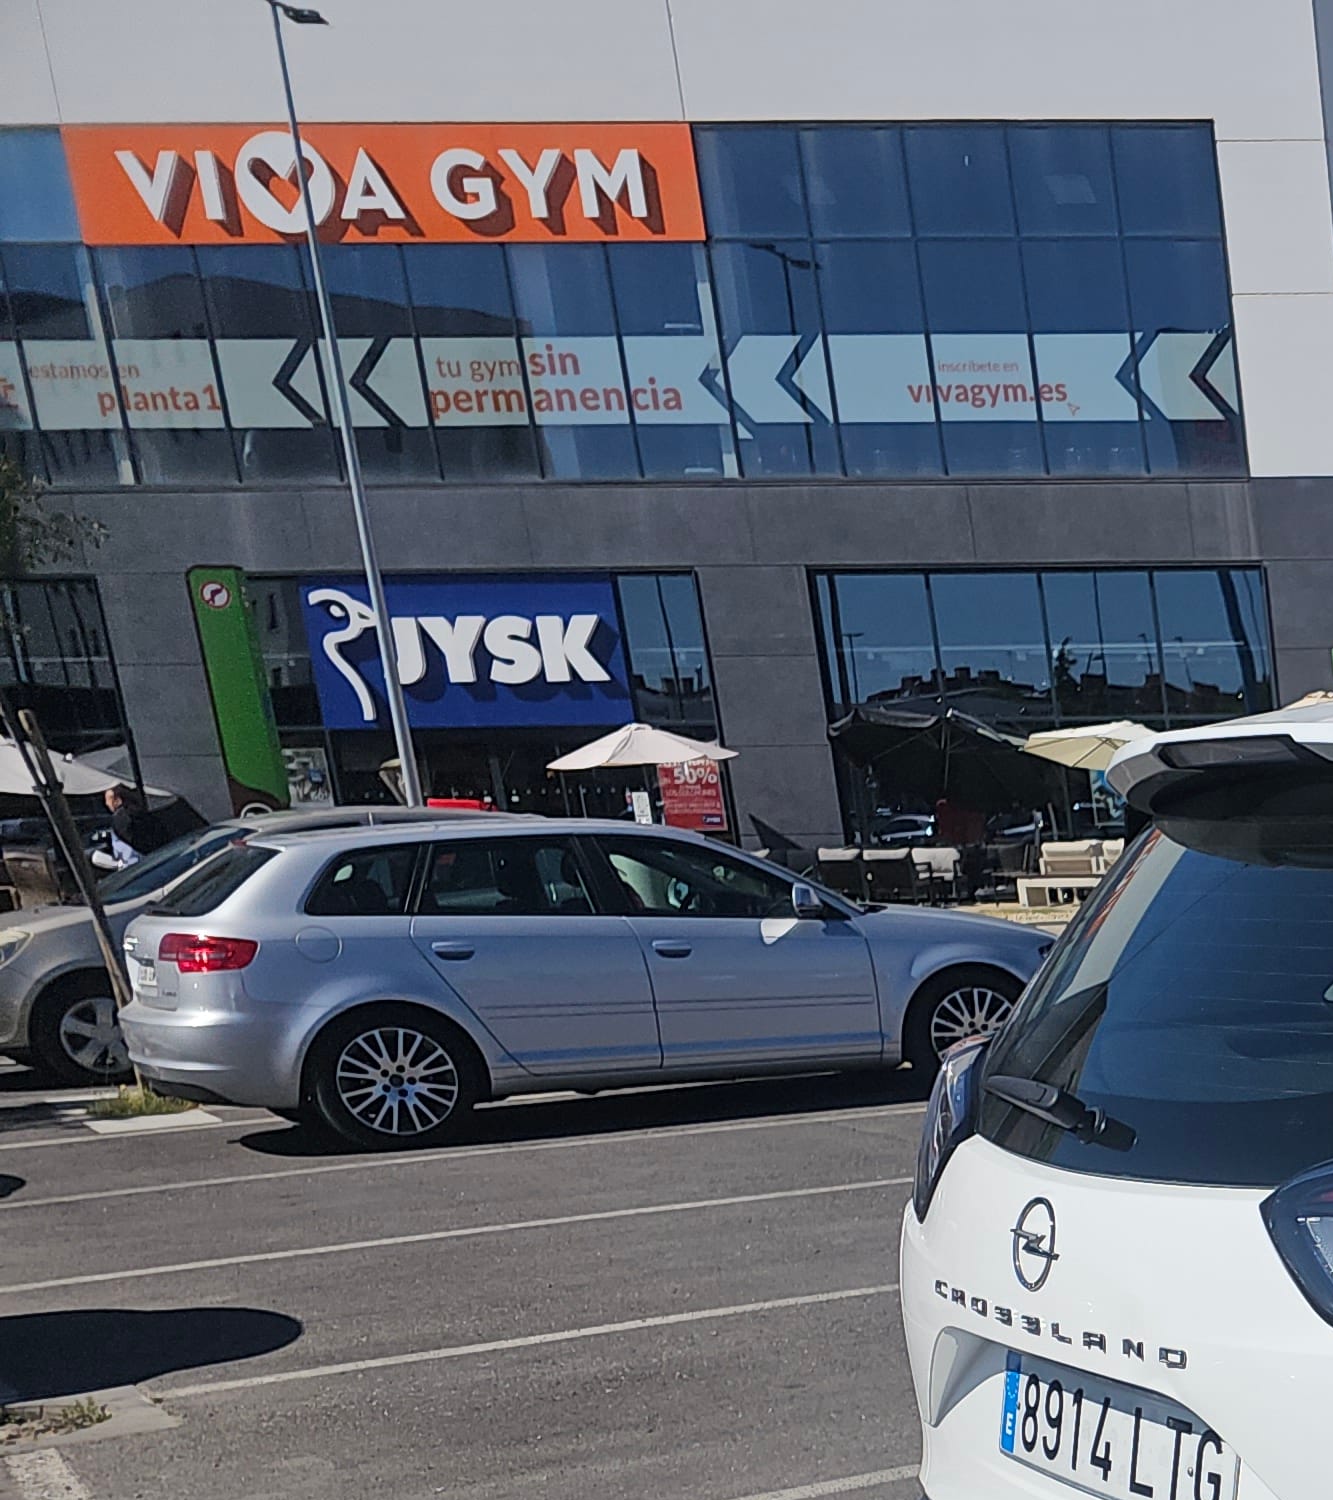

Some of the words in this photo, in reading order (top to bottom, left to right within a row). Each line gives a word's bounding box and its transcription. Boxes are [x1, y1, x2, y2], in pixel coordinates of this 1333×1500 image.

[430, 148, 648, 220] GYM
[29, 363, 109, 379] estamos
[116, 364, 140, 378] en
[436, 356, 461, 377] tu
[470, 359, 522, 382] gym
[529, 344, 581, 376] sin
[1003, 361, 1019, 372] en
[430, 377, 682, 419] permanencia
[907, 383, 1067, 408] vivagym.es
[392, 614, 611, 684] JYSK
[674, 767, 717, 784] 50%
[935, 1279, 1187, 1368] CROSSLAND
[1005, 1411, 1014, 1435] E
[1021, 1374, 1112, 1482] 8914
